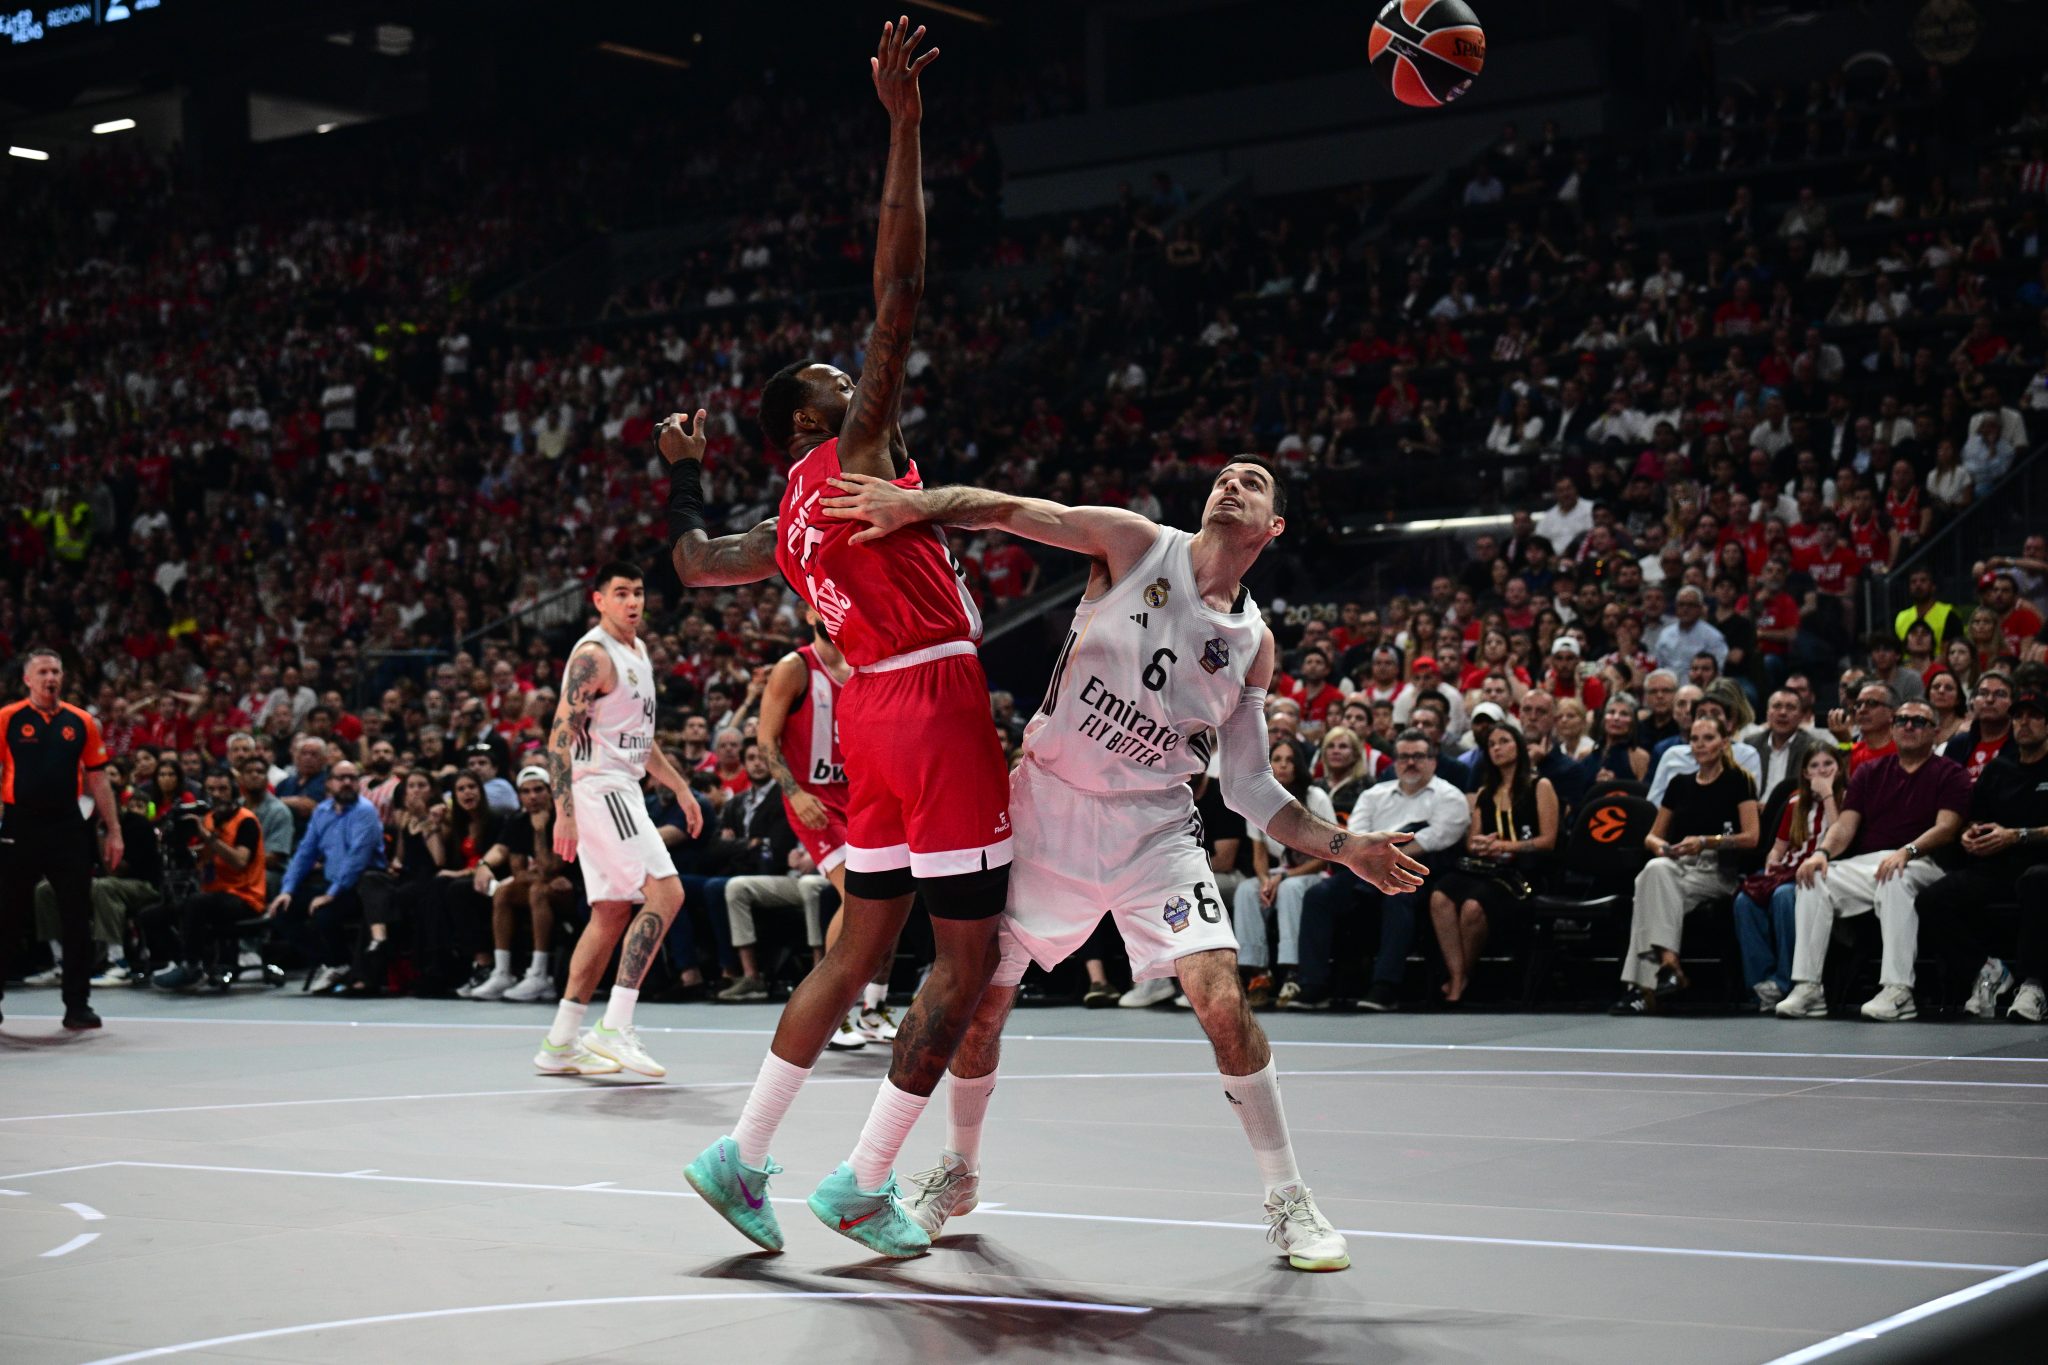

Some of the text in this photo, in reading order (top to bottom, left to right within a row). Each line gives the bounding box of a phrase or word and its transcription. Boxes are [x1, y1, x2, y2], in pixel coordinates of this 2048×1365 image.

[1142, 647, 1178, 692] 6
[1078, 714, 1163, 767] FLY BETTER
[1193, 881, 1222, 924] 6
